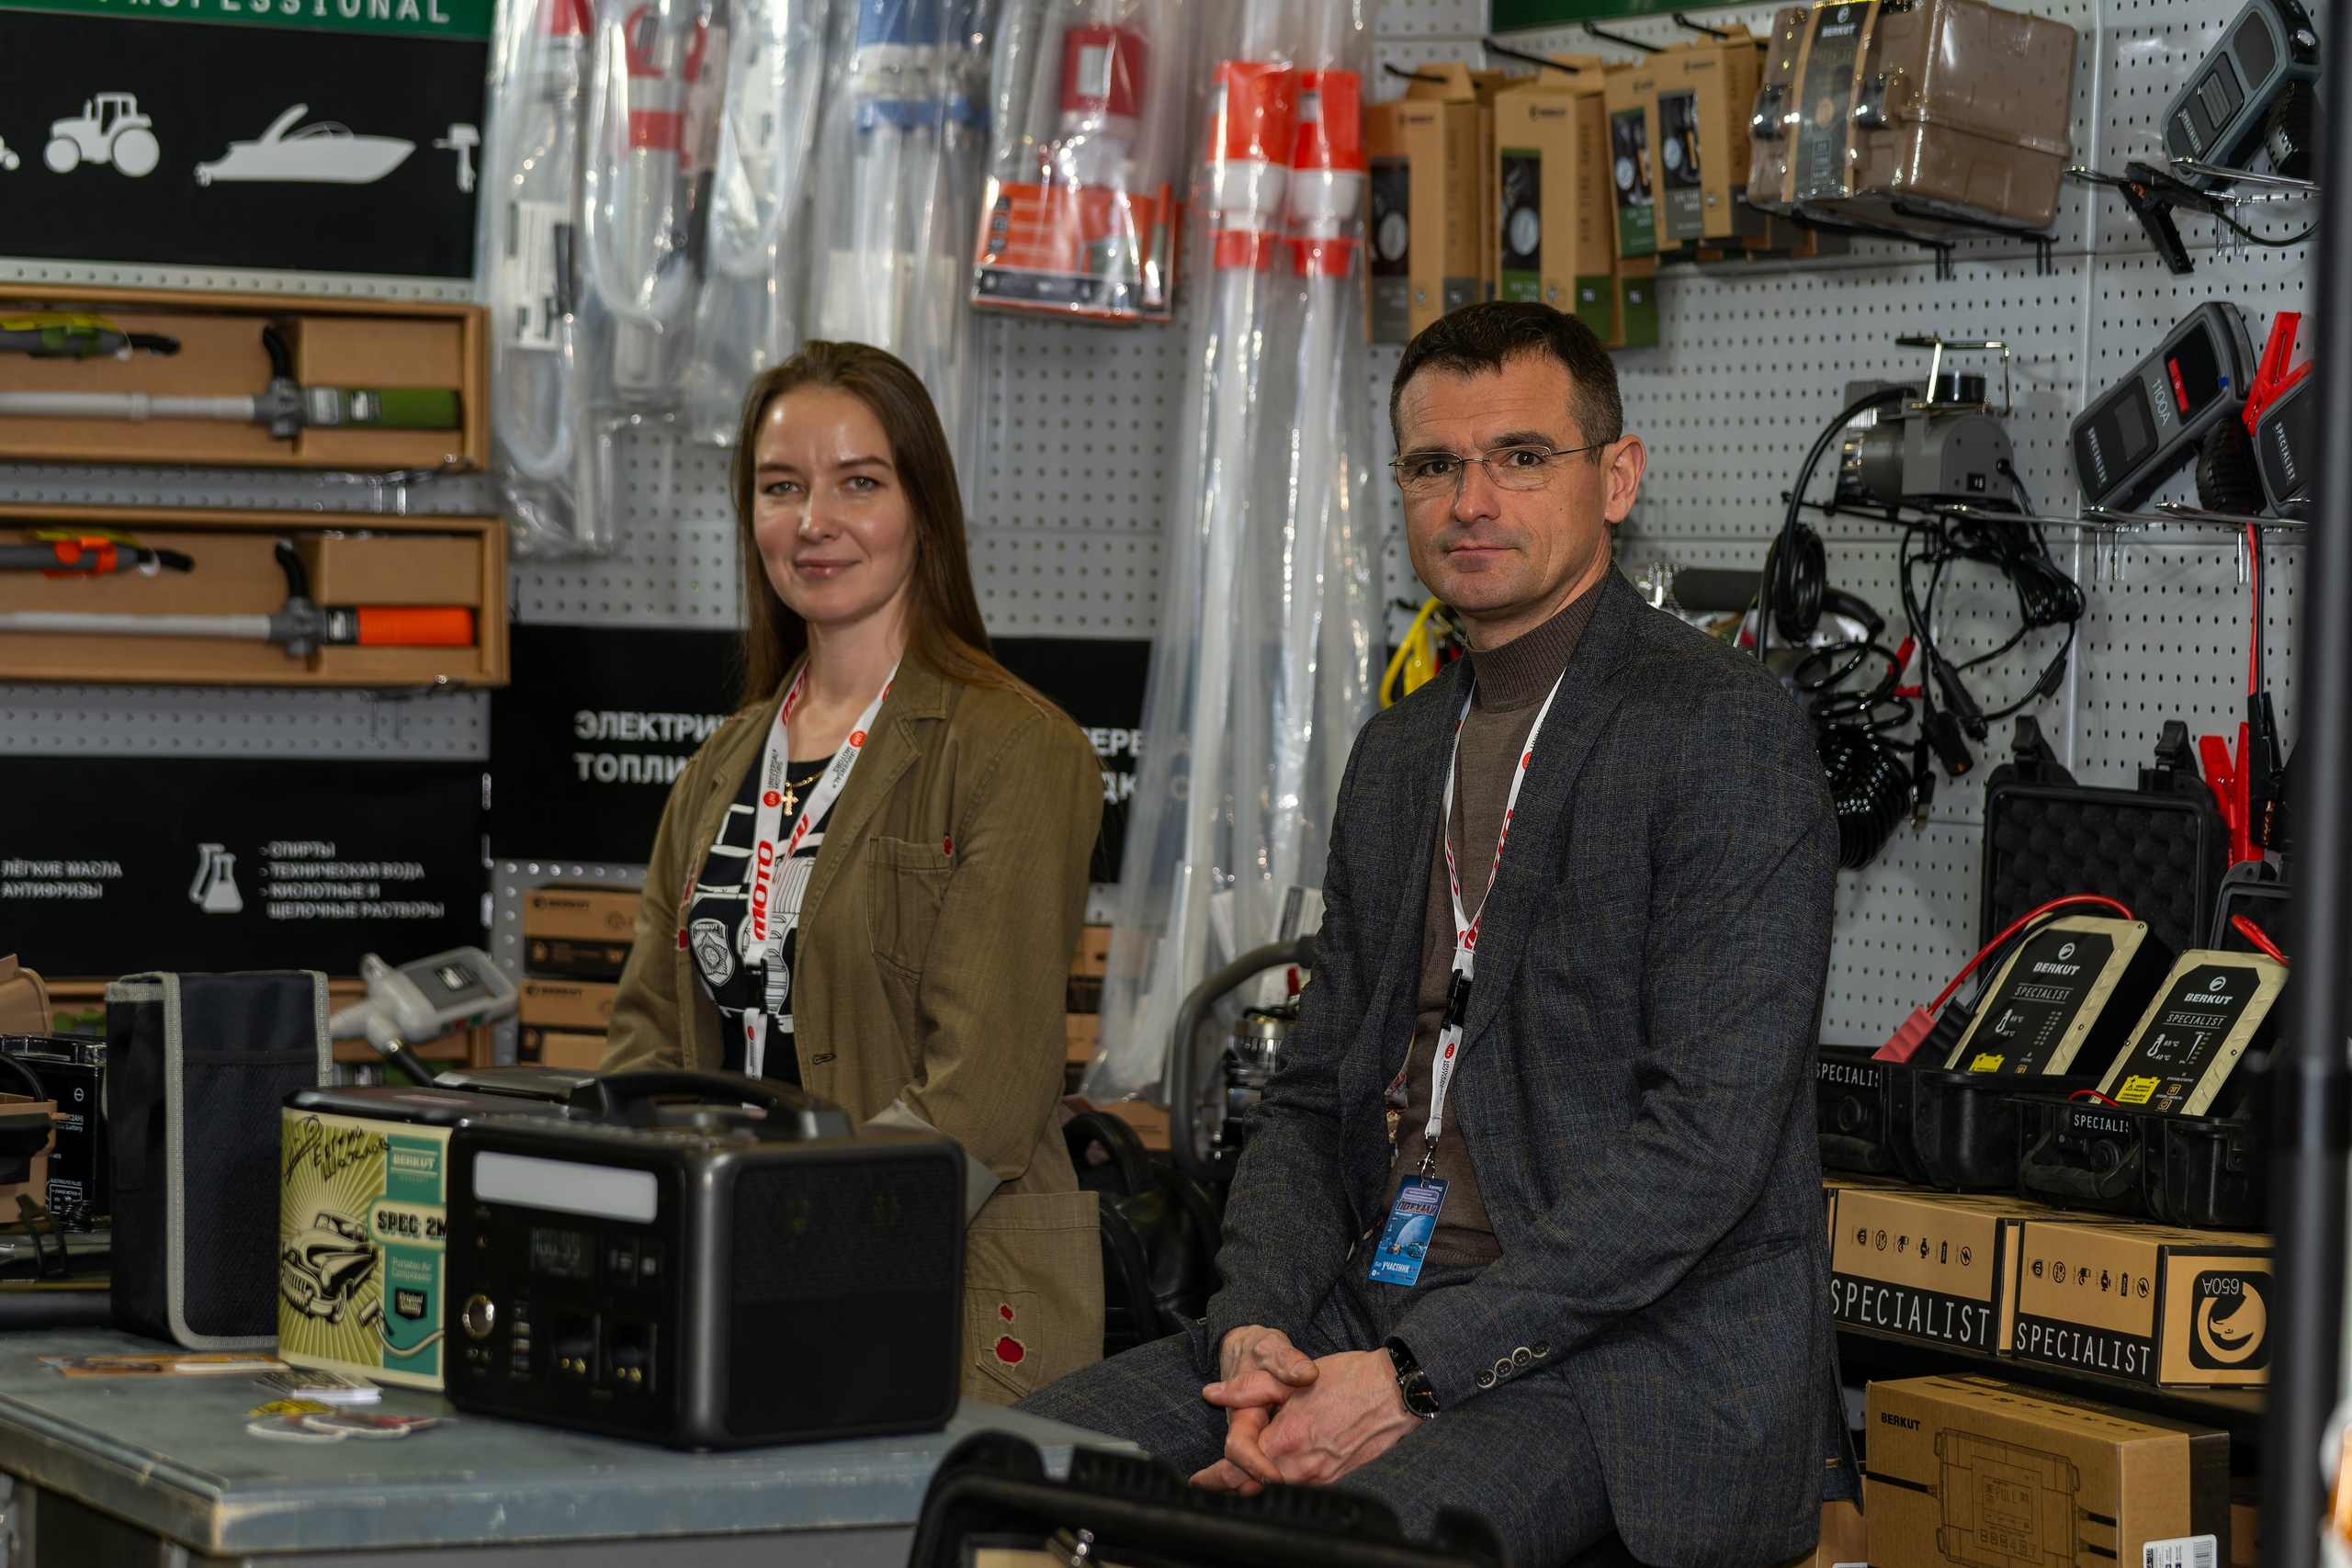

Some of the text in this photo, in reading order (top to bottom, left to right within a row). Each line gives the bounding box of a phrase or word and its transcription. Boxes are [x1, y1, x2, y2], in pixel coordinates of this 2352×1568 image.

[100, 0, 450, 24] SSIONAL
[2151, 378, 2172, 427] 1100A
[2087, 426, 2109, 484] SPECIALIST
[2275, 422, 2296, 480] SPECIALIST
[267, 840, 336, 859] СПИРТЫ
[65, 861, 123, 878] МАСЛА
[267, 862, 425, 881] ТЕХНИЧЕСКАЯ ВОДА
[1, 881, 103, 899] АНТИФРИЗЫ
[267, 882, 380, 899] КИСЛОТНЫЕ И
[752, 840, 774, 941] MOTO
[266, 901, 445, 920] ЩЕЛОЧНЫЕ РАСТВОРЫ
[2032, 962, 2080, 976] BERKUT
[2015, 987, 2070, 1001] SPECIALIST
[2184, 993, 2233, 1005] BERKUT
[2166, 1014, 2224, 1026] SPECIALIST
[65, 1124, 83, 1133] Battery
[393, 1154, 435, 1169] BERKUT
[378, 1210, 420, 1236] SPEC
[392, 1257, 433, 1271] Portable Air
[1381, 1261, 1410, 1273] УЧАСТНИК
[391, 1268, 434, 1283] Compressor
[2201, 1278, 2240, 1295] 650A
[1831, 1279, 1990, 1345] SPECIALIST
[2017, 1322, 2151, 1376] SPECIALIST
[1881, 1412, 1920, 1431] BERKUT
[1995, 1484, 2018, 1504] FULL
